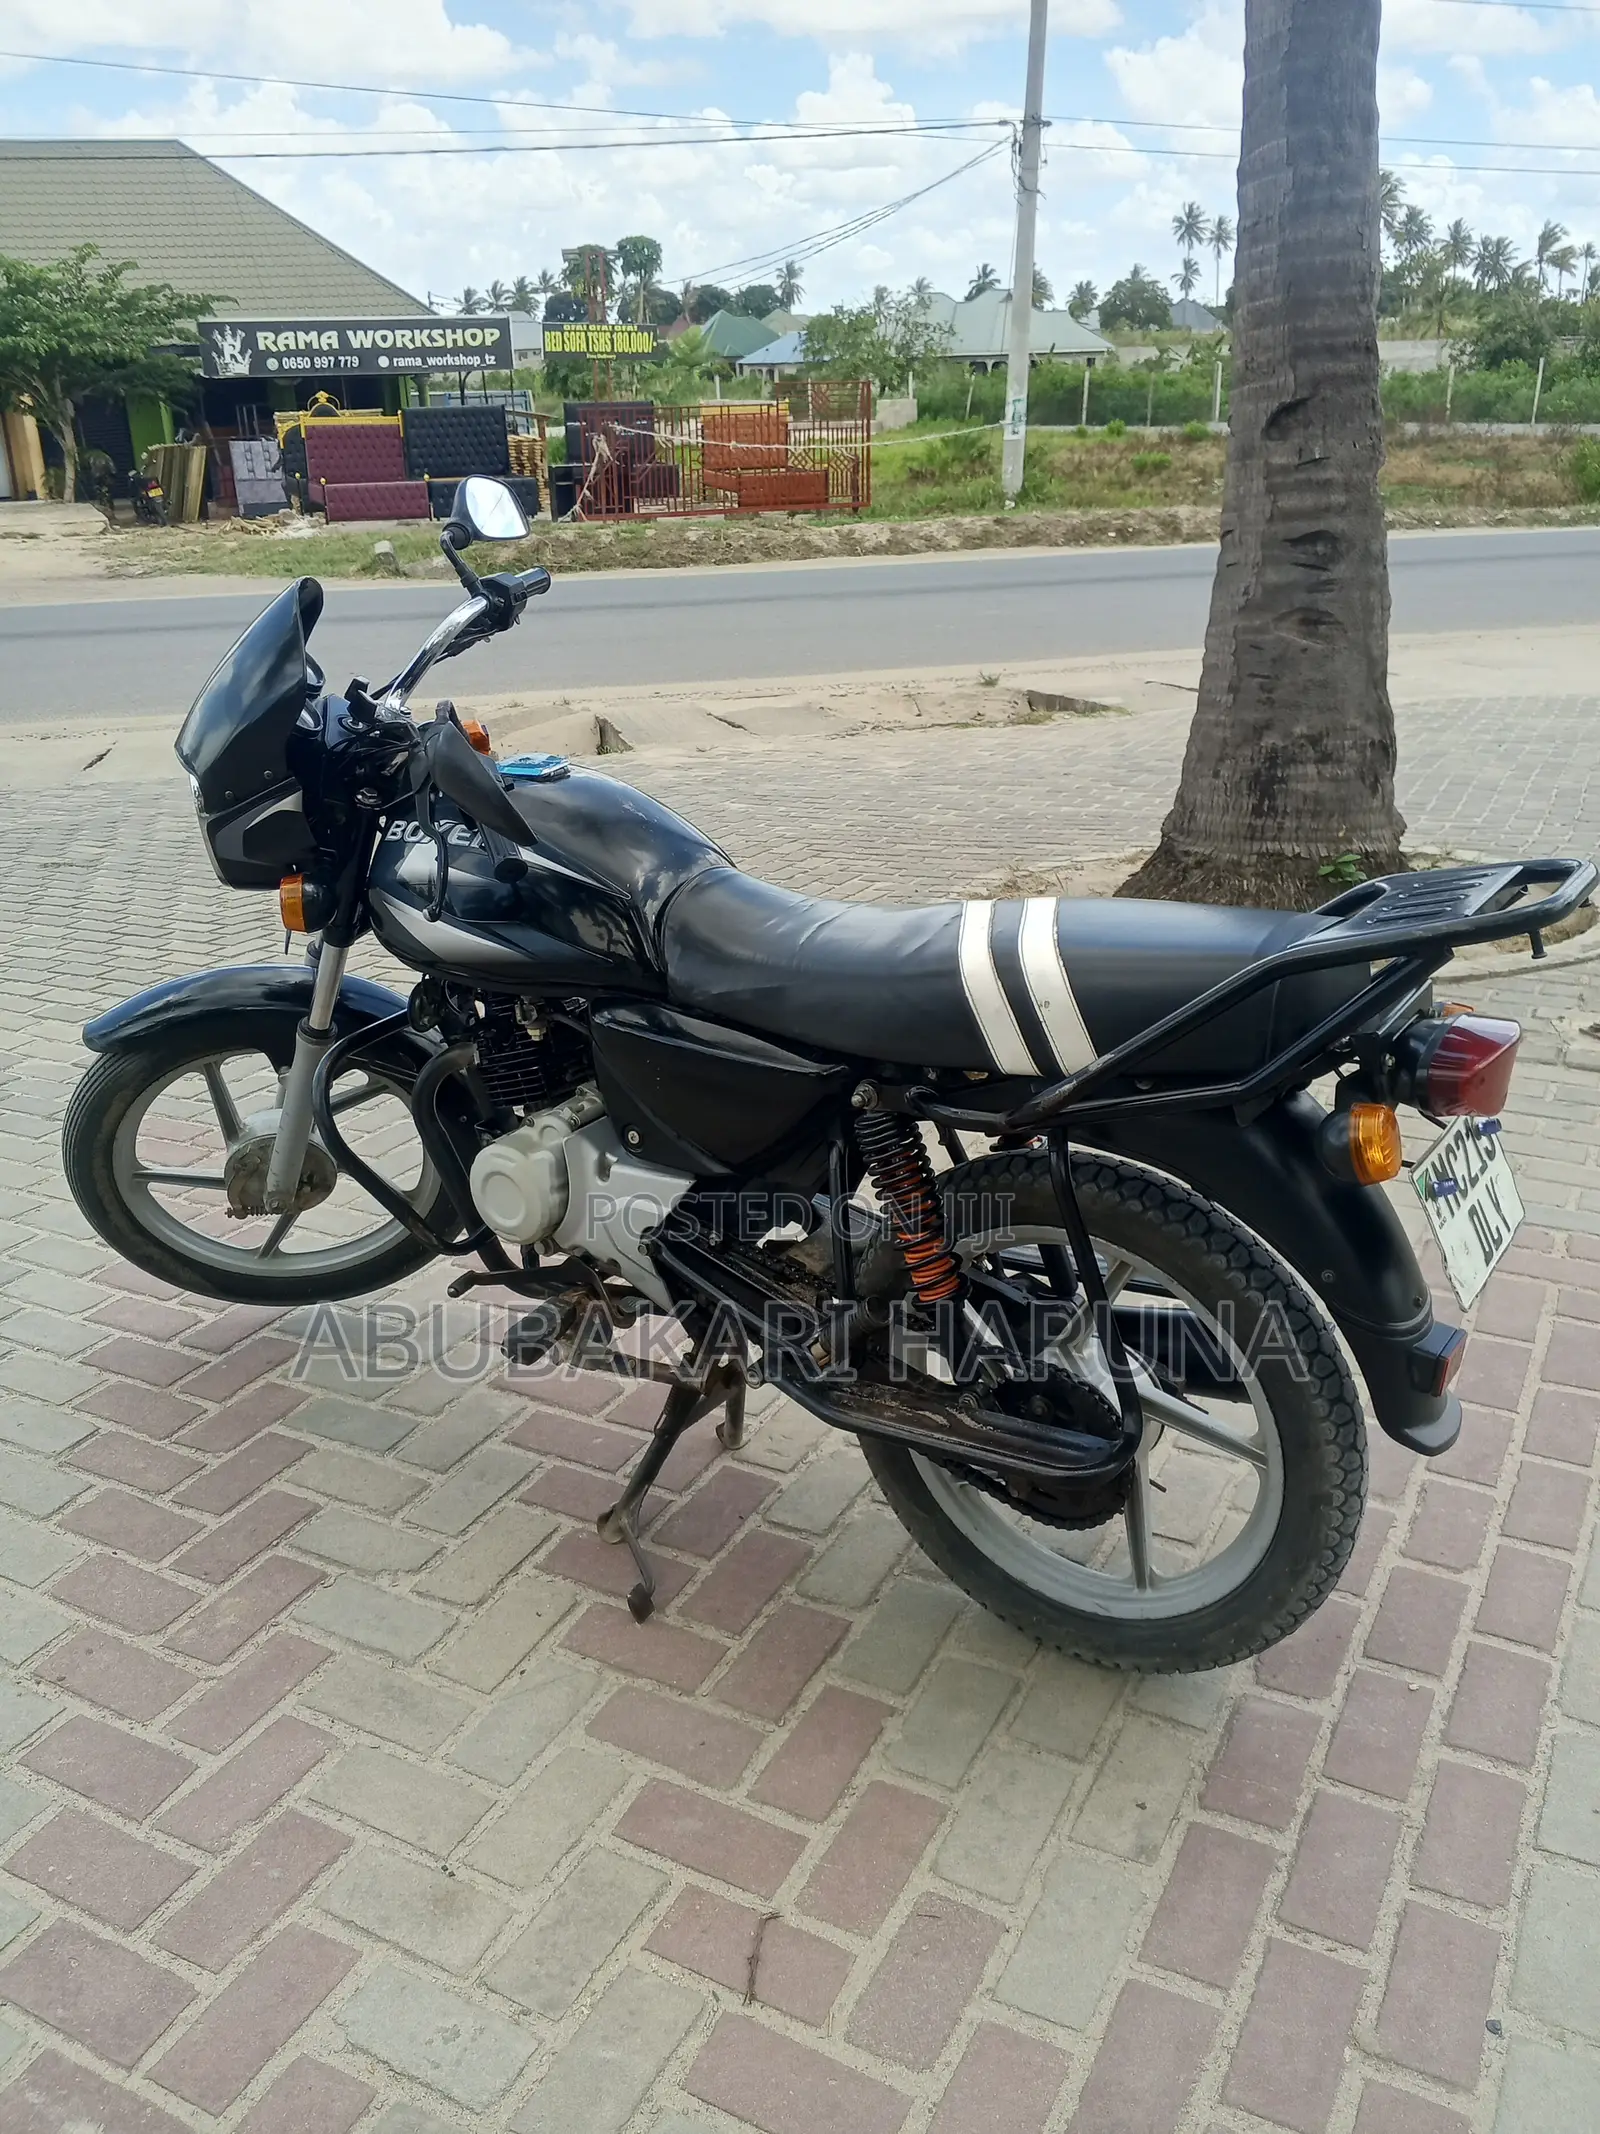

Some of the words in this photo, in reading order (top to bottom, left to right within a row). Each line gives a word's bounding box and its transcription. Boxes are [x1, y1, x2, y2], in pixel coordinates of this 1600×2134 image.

[256, 330, 339, 353] RAMA
[346, 328, 501, 350] WORKSHOP
[544, 331, 562, 352] BED
[563, 331, 587, 353] SOFA
[587, 331, 612, 353] TSHS
[612, 331, 658, 354] 180,000/-
[282, 356, 311, 370] 0650
[313, 356, 335, 369] 997
[338, 356, 360, 369] 779
[393, 353, 497, 368] rama_workshop_tz
[1468, 1175, 1511, 1267] DLY
